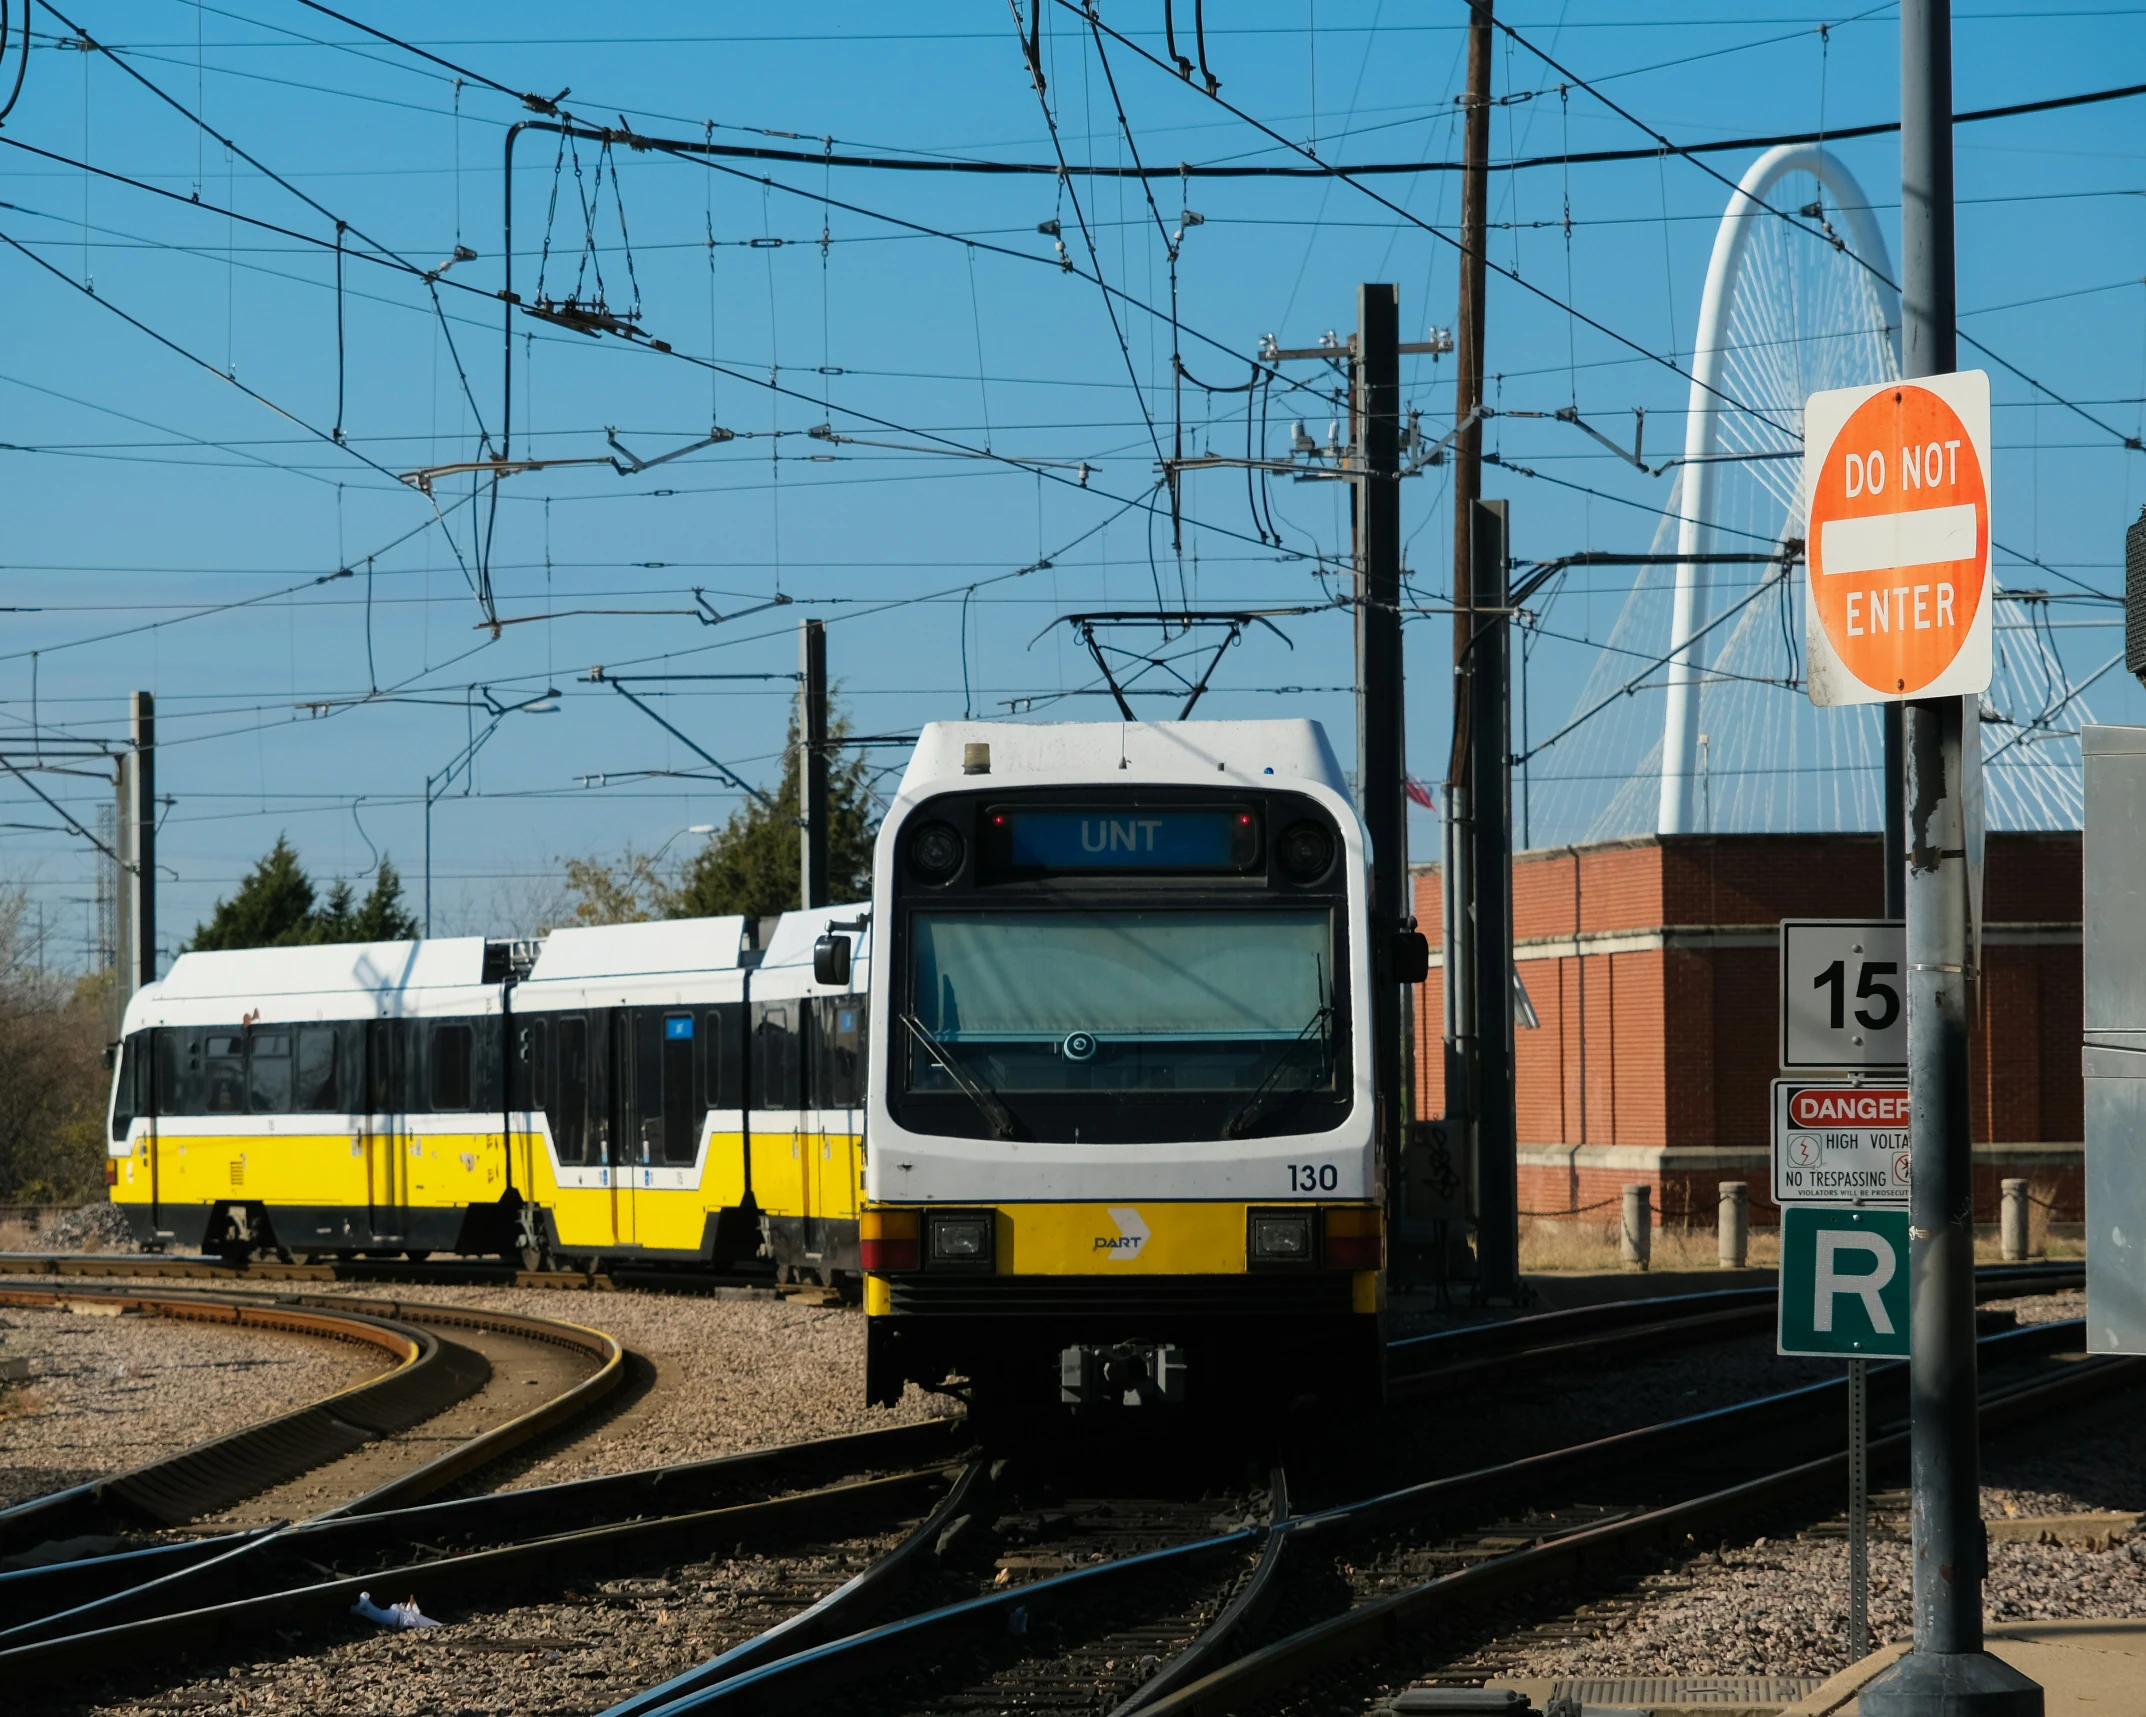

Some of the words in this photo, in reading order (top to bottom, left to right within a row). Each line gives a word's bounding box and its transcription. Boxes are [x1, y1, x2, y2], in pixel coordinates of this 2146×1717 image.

[1845, 450, 1886, 499] DO
[1902, 439, 1961, 491] NOT
[1847, 582, 1955, 637] ENTER
[1081, 820, 1163, 852] UNT
[1813, 960, 1900, 1030] 15
[1826, 1133, 1858, 1149] HIGH
[1287, 1164, 1338, 1192] 130
[1786, 1171, 1803, 1187] NO
[1810, 1171, 1886, 1187] TRESPASSING
[1094, 1236, 1142, 1248] DART
[1813, 1229, 1896, 1334] R
